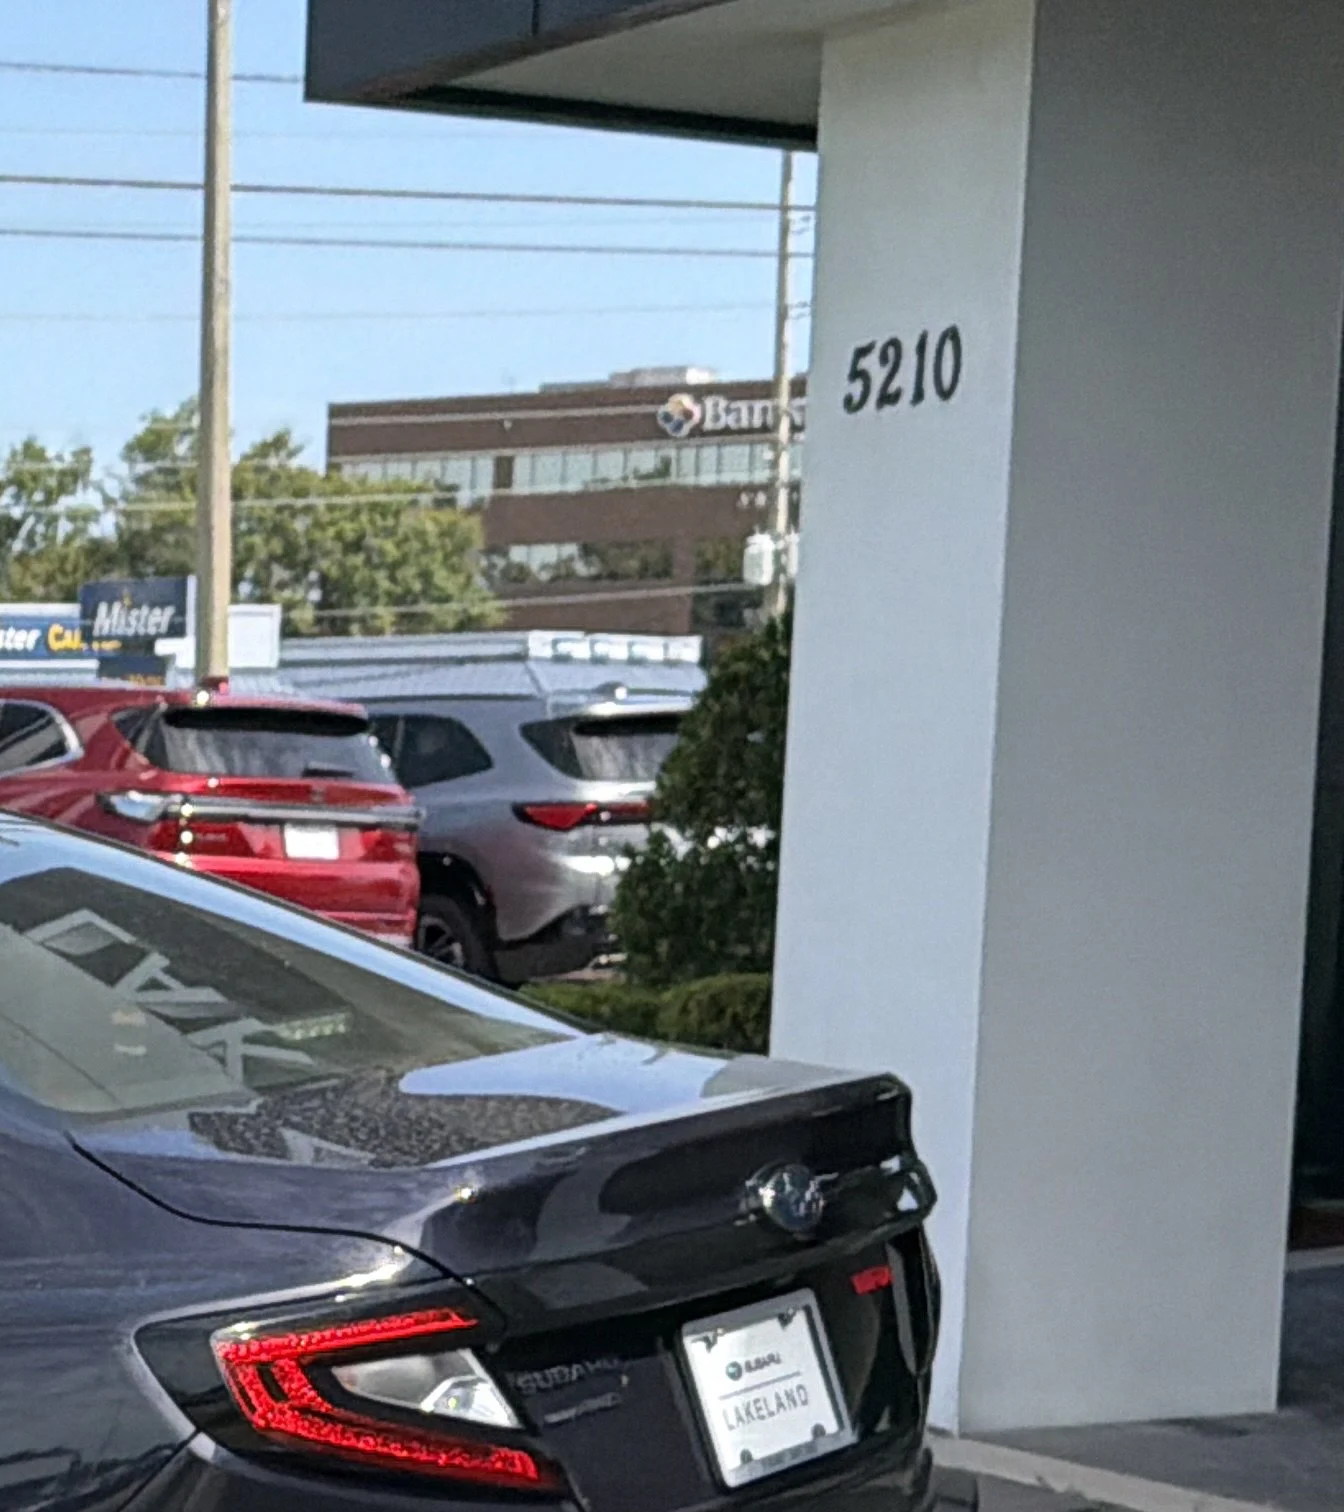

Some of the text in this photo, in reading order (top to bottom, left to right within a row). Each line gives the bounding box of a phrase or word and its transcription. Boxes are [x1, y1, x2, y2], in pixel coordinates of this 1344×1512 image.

[843, 324, 963, 414] 5210
[702, 394, 806, 432] Ban
[93, 600, 175, 637] Mister
[722, 1383, 809, 1432] LAKELAND
